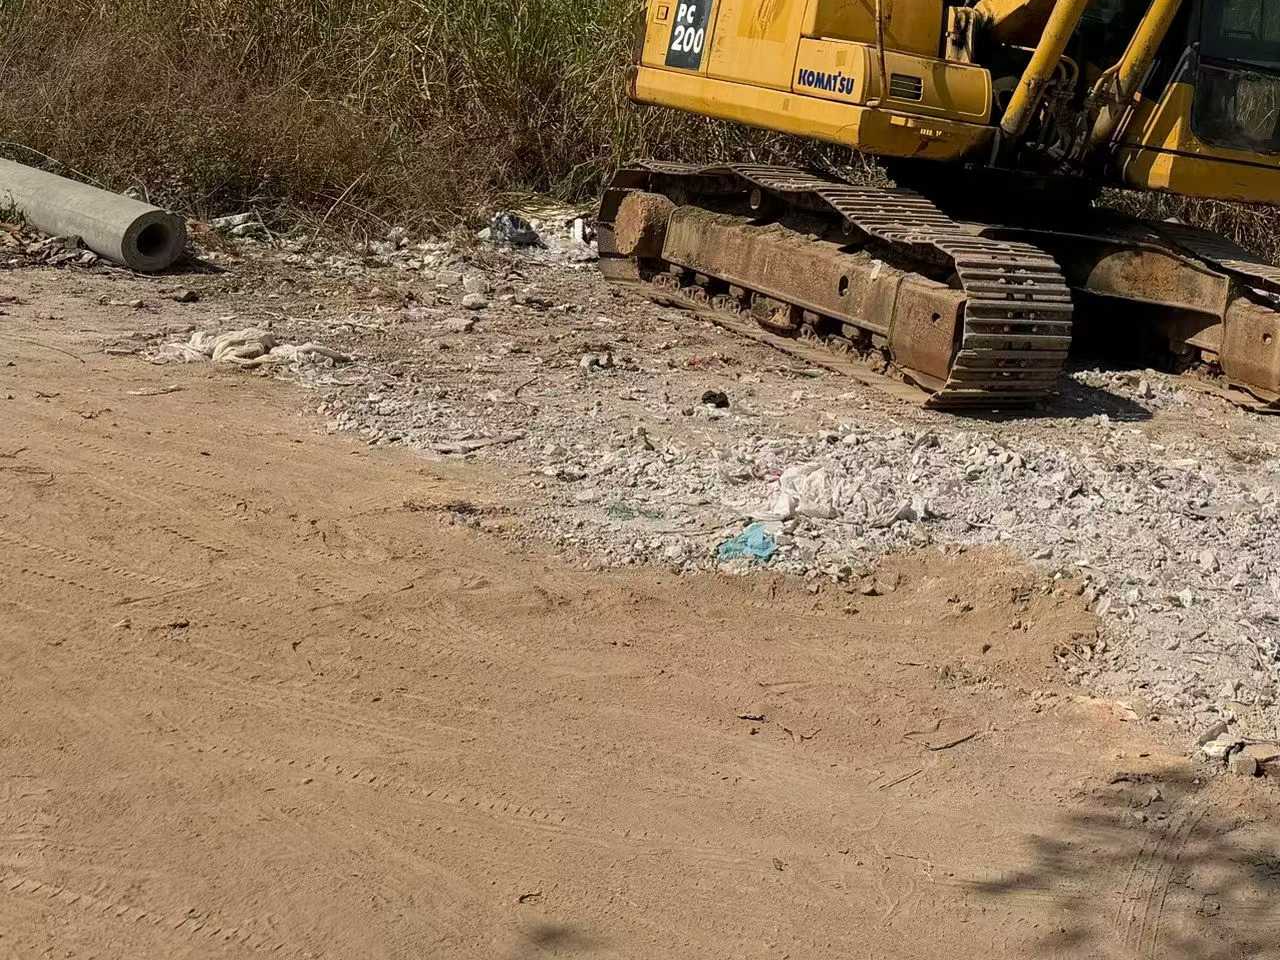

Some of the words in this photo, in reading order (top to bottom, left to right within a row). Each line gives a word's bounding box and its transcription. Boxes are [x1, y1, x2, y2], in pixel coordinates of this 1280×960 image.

[677, 3, 697, 24] PC
[670, 25, 705, 54] 200
[797, 68, 855, 95] KOMATSU
